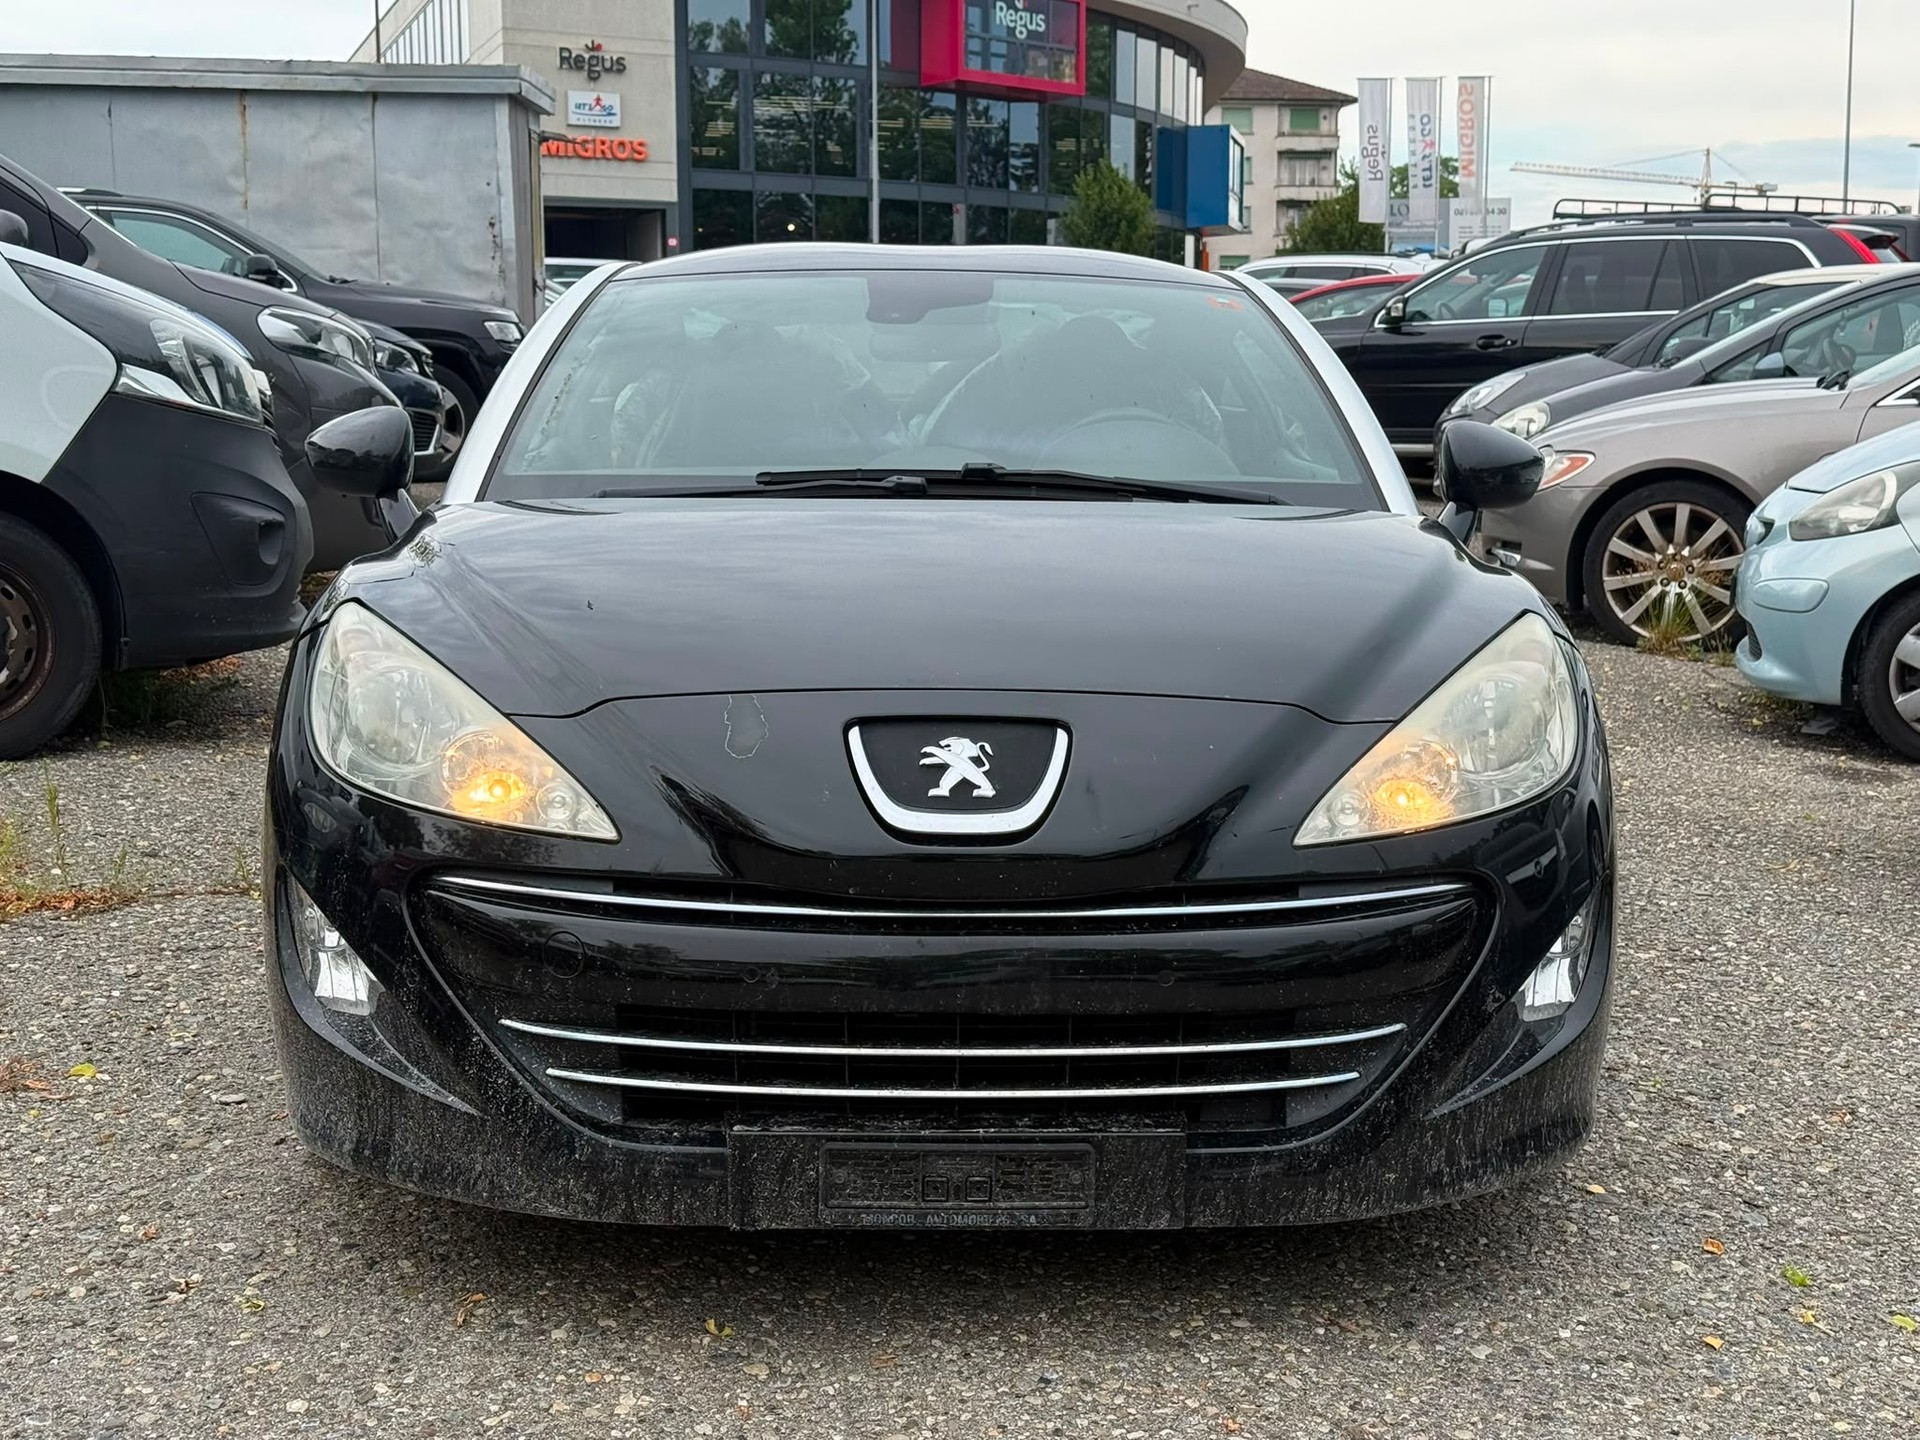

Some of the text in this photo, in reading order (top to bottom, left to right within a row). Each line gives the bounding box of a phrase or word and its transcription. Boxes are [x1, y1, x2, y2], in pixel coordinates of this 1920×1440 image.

[995, 1, 1046, 39] Regus
[558, 47, 627, 80] Regus
[541, 135, 649, 161] MIGROS
